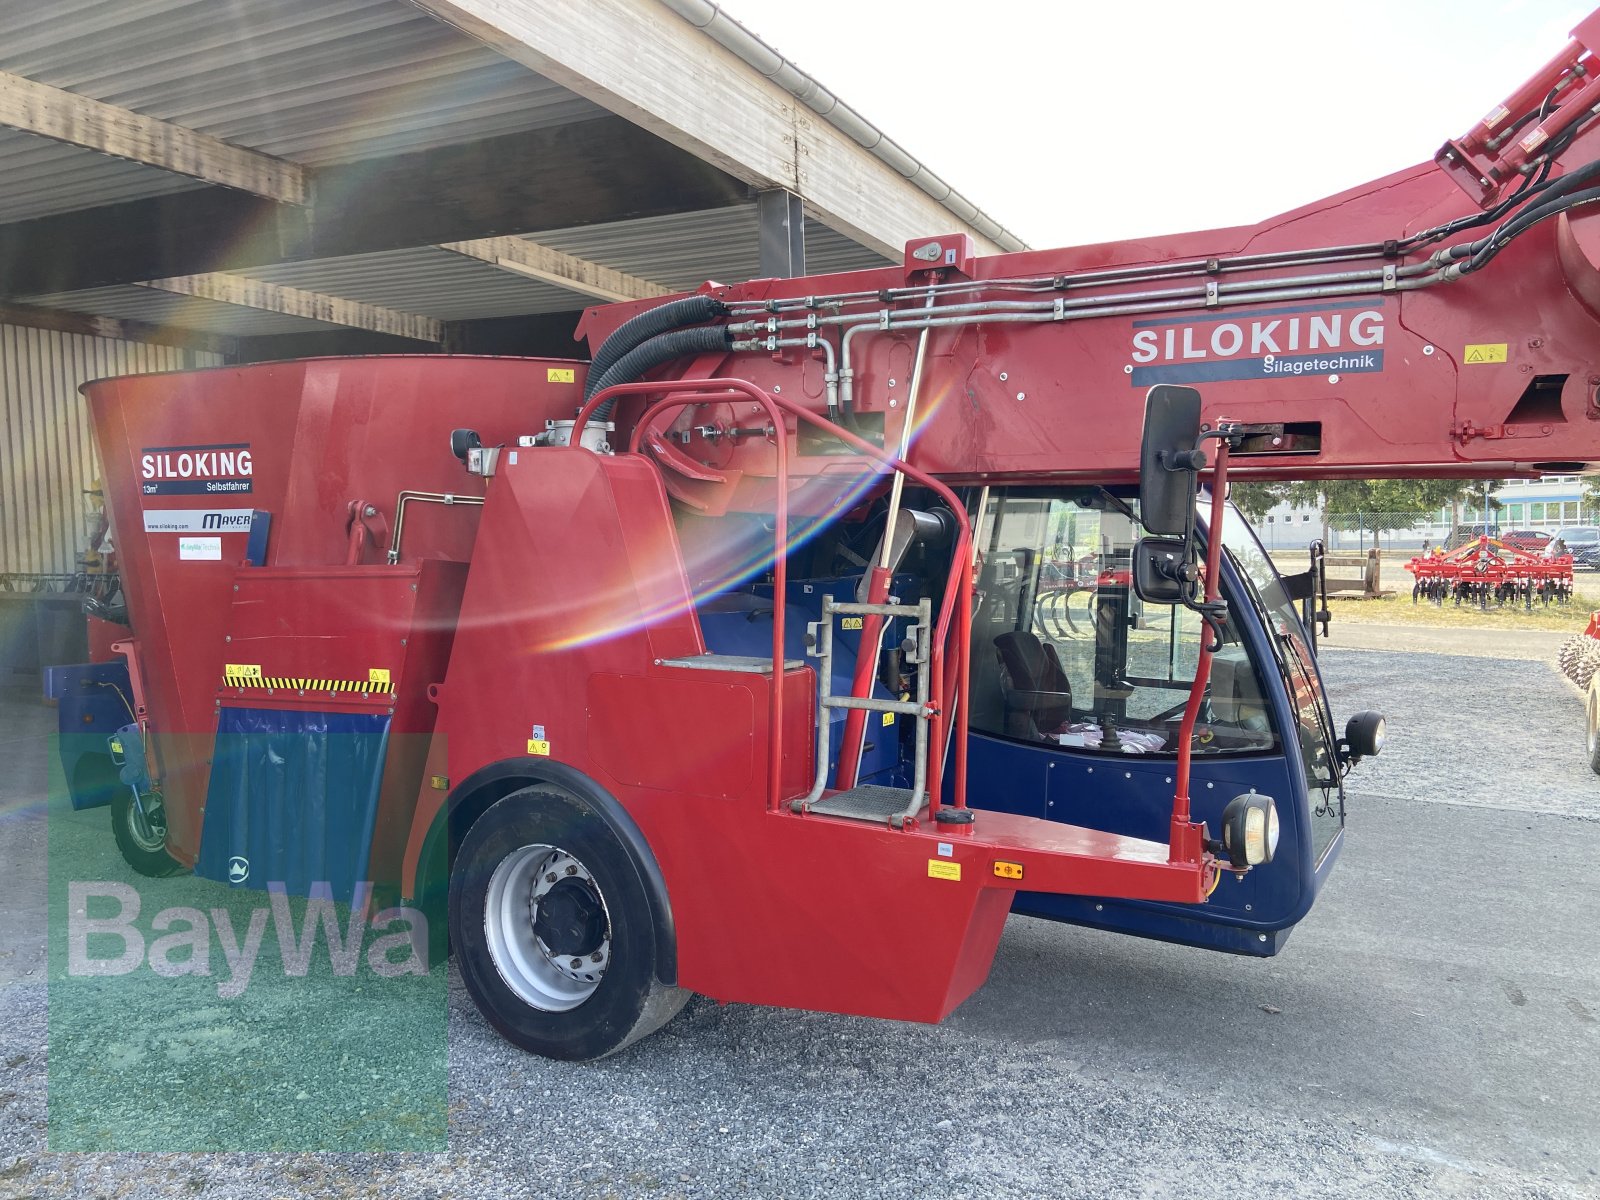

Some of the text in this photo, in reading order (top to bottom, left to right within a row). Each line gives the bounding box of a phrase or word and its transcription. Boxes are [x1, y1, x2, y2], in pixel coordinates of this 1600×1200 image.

[1131, 310, 1385, 363] SILOKING
[1263, 355, 1374, 375] Silagetechnik
[142, 450, 253, 478] SILOKING
[206, 482, 250, 492] Selbstfahrer
[202, 513, 251, 529] MAYER
